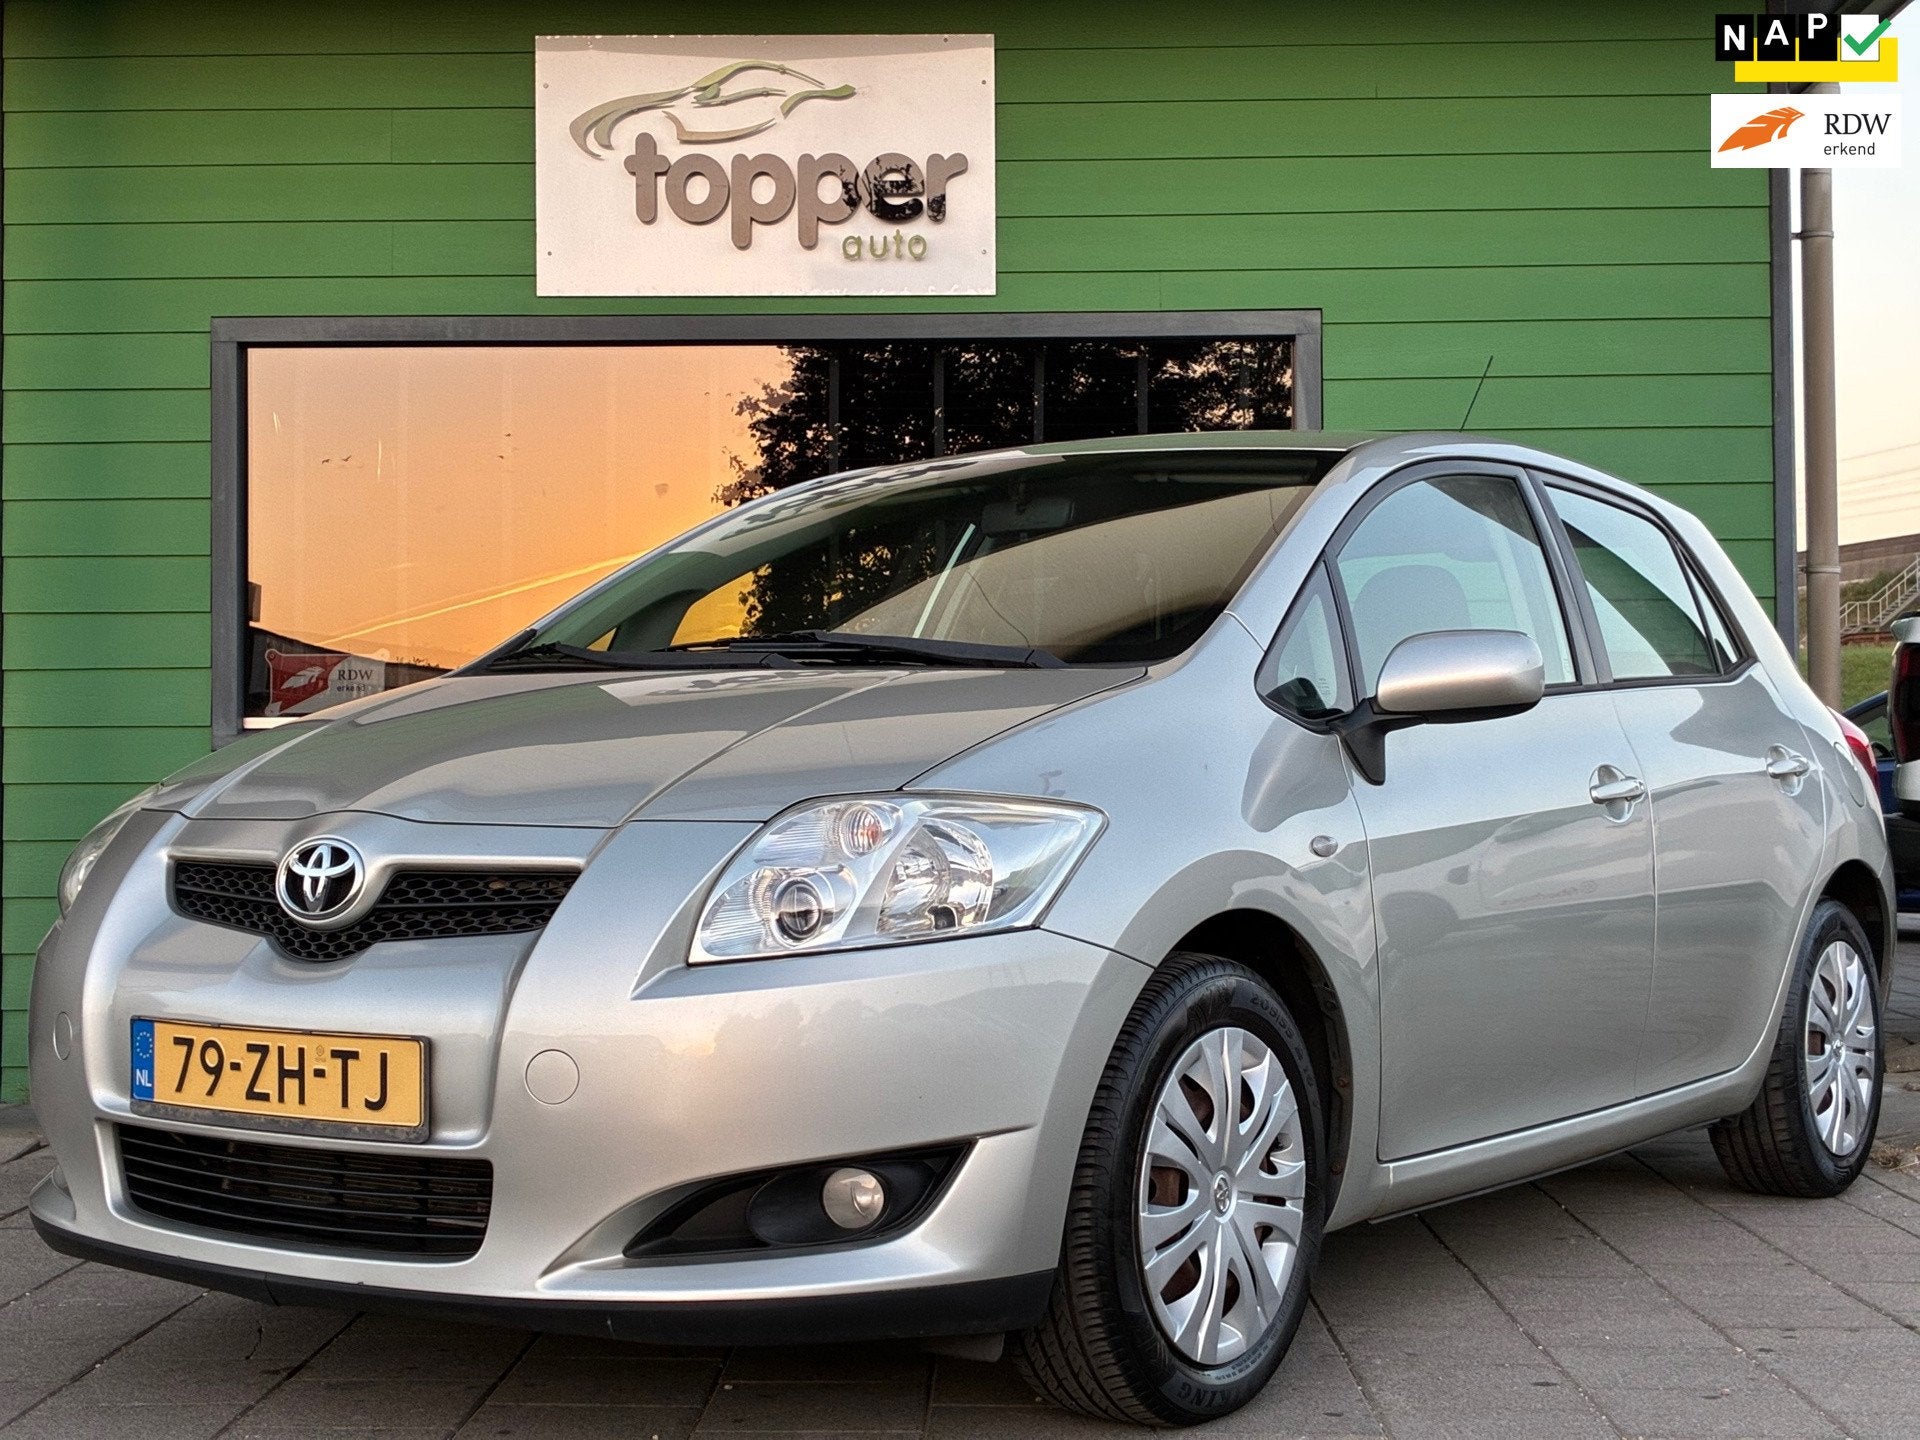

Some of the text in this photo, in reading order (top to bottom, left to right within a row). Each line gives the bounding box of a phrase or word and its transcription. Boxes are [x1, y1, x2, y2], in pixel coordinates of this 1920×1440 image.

[624, 132, 968, 250] topper
[842, 229, 927, 261] auto
[337, 669, 374, 681] RDW
[136, 1069, 152, 1087] NL
[172, 1035, 388, 1112] 79-ZH-TJ
